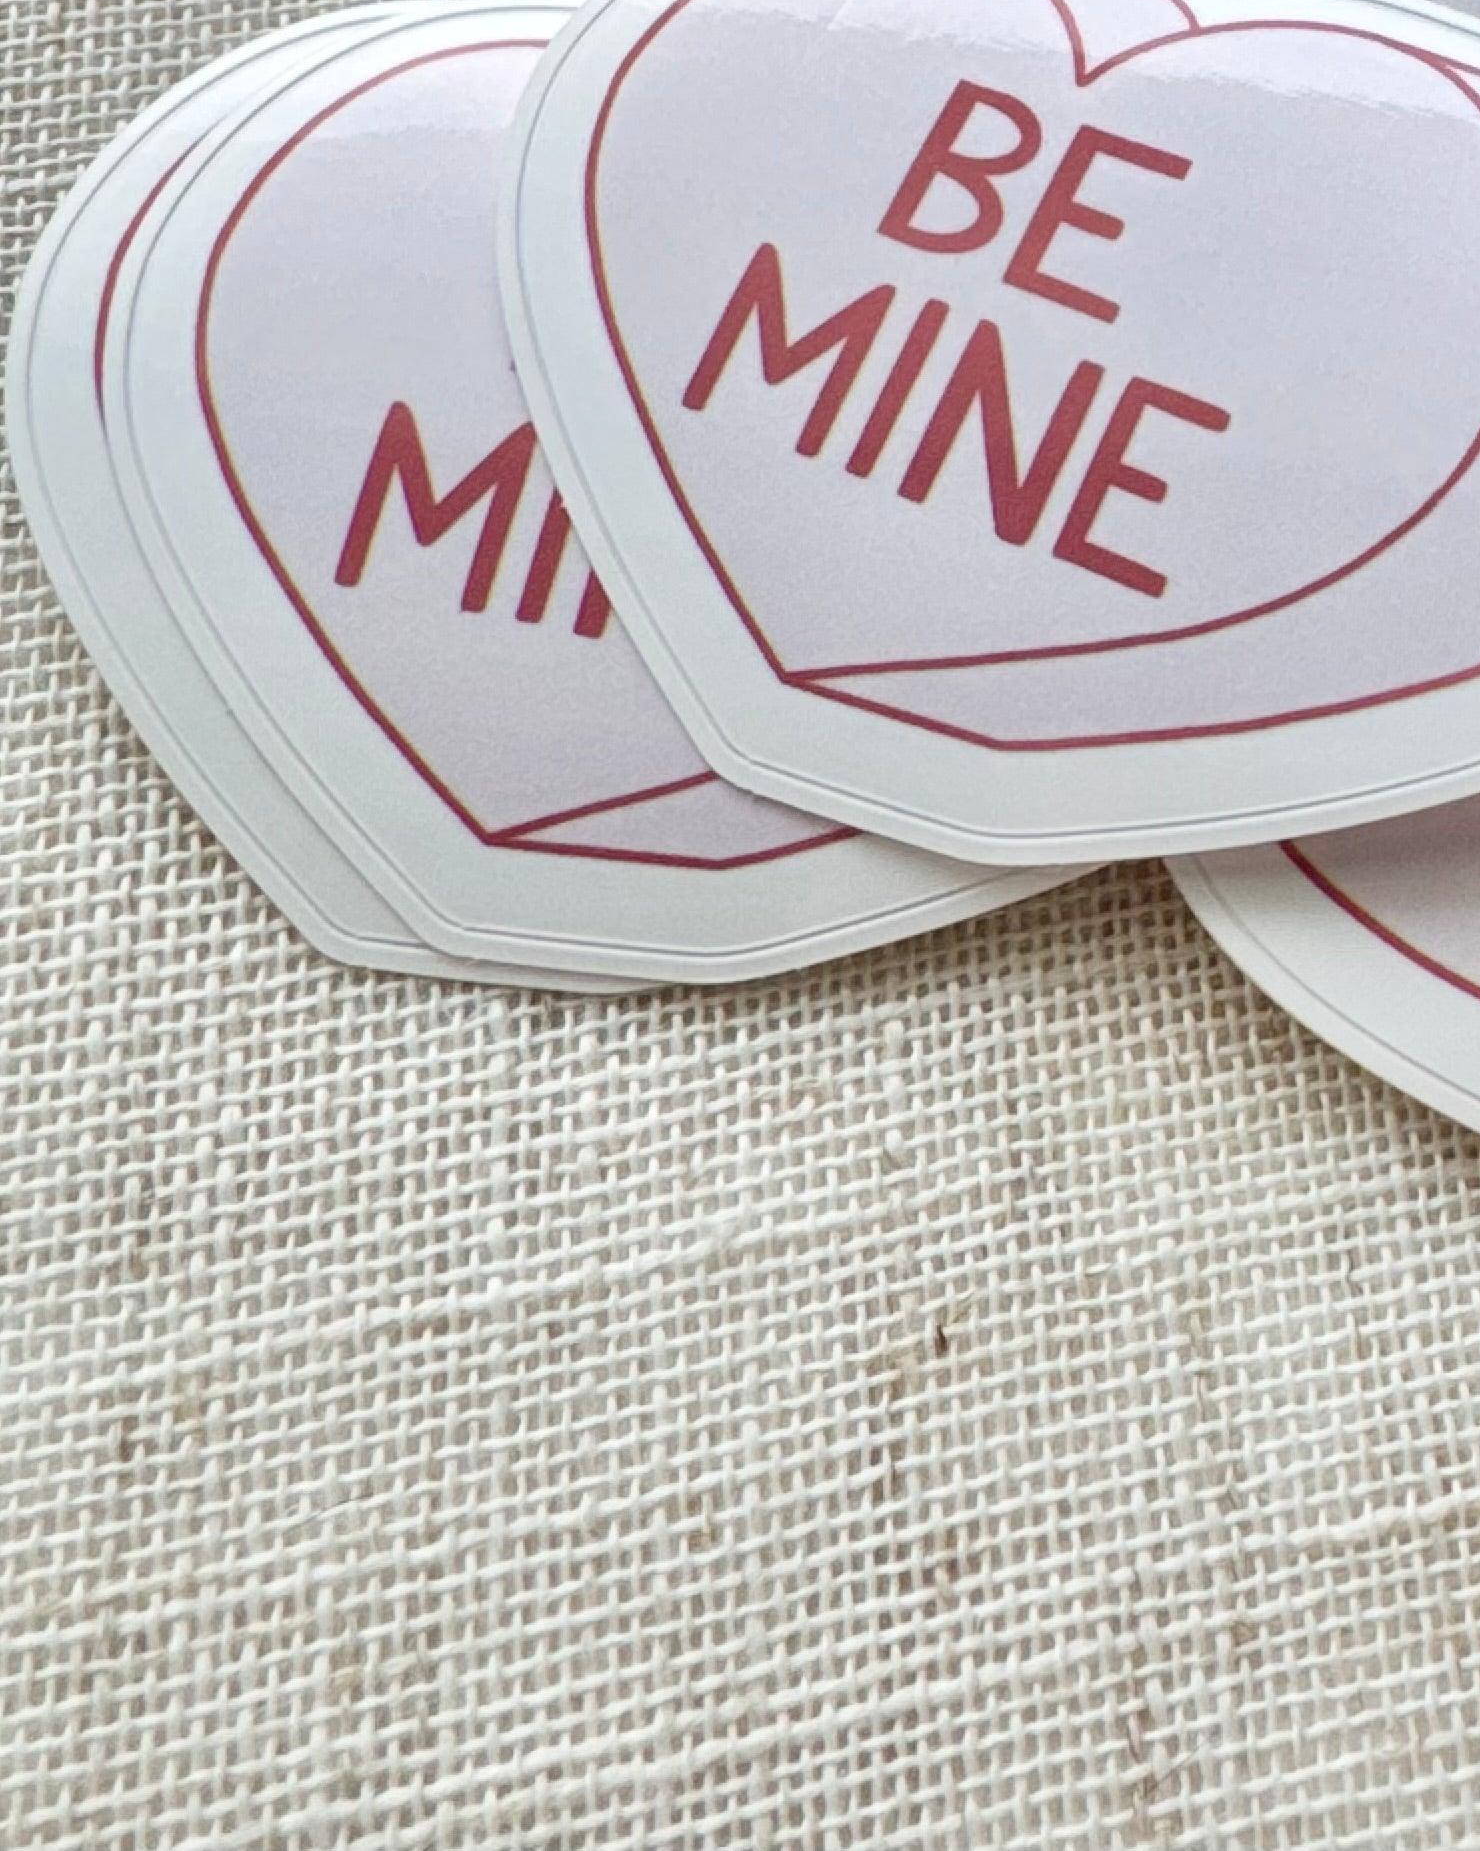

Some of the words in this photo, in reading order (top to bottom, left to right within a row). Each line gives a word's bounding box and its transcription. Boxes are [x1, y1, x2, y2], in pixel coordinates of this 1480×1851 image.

[876, 79, 1193, 323] BE
[334, 400, 613, 639] MI
[681, 243, 1231, 599] MINE
